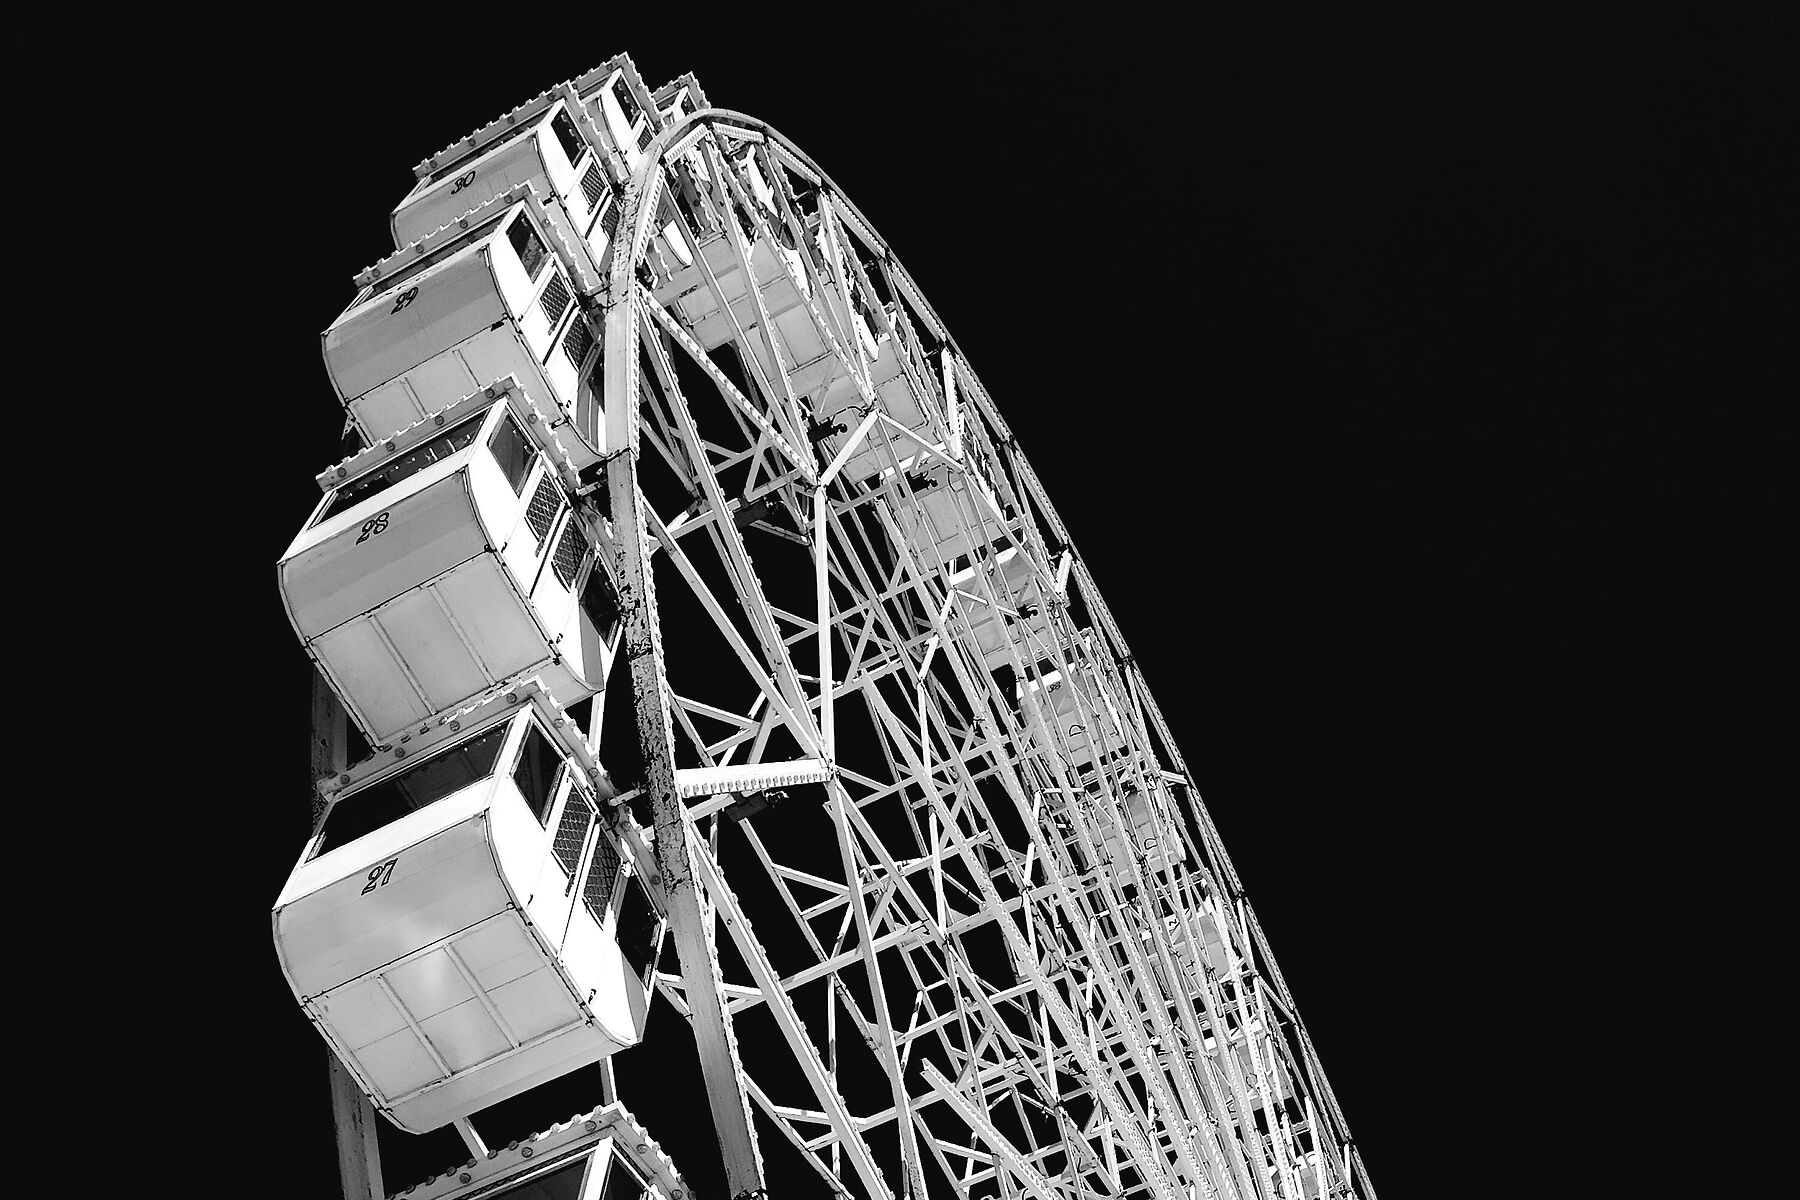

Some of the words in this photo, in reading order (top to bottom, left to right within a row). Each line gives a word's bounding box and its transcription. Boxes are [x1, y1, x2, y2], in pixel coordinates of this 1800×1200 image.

[451, 170, 476, 195] 30
[390, 286, 419, 315] 29
[355, 512, 390, 546] 28
[360, 857, 399, 896] 27
